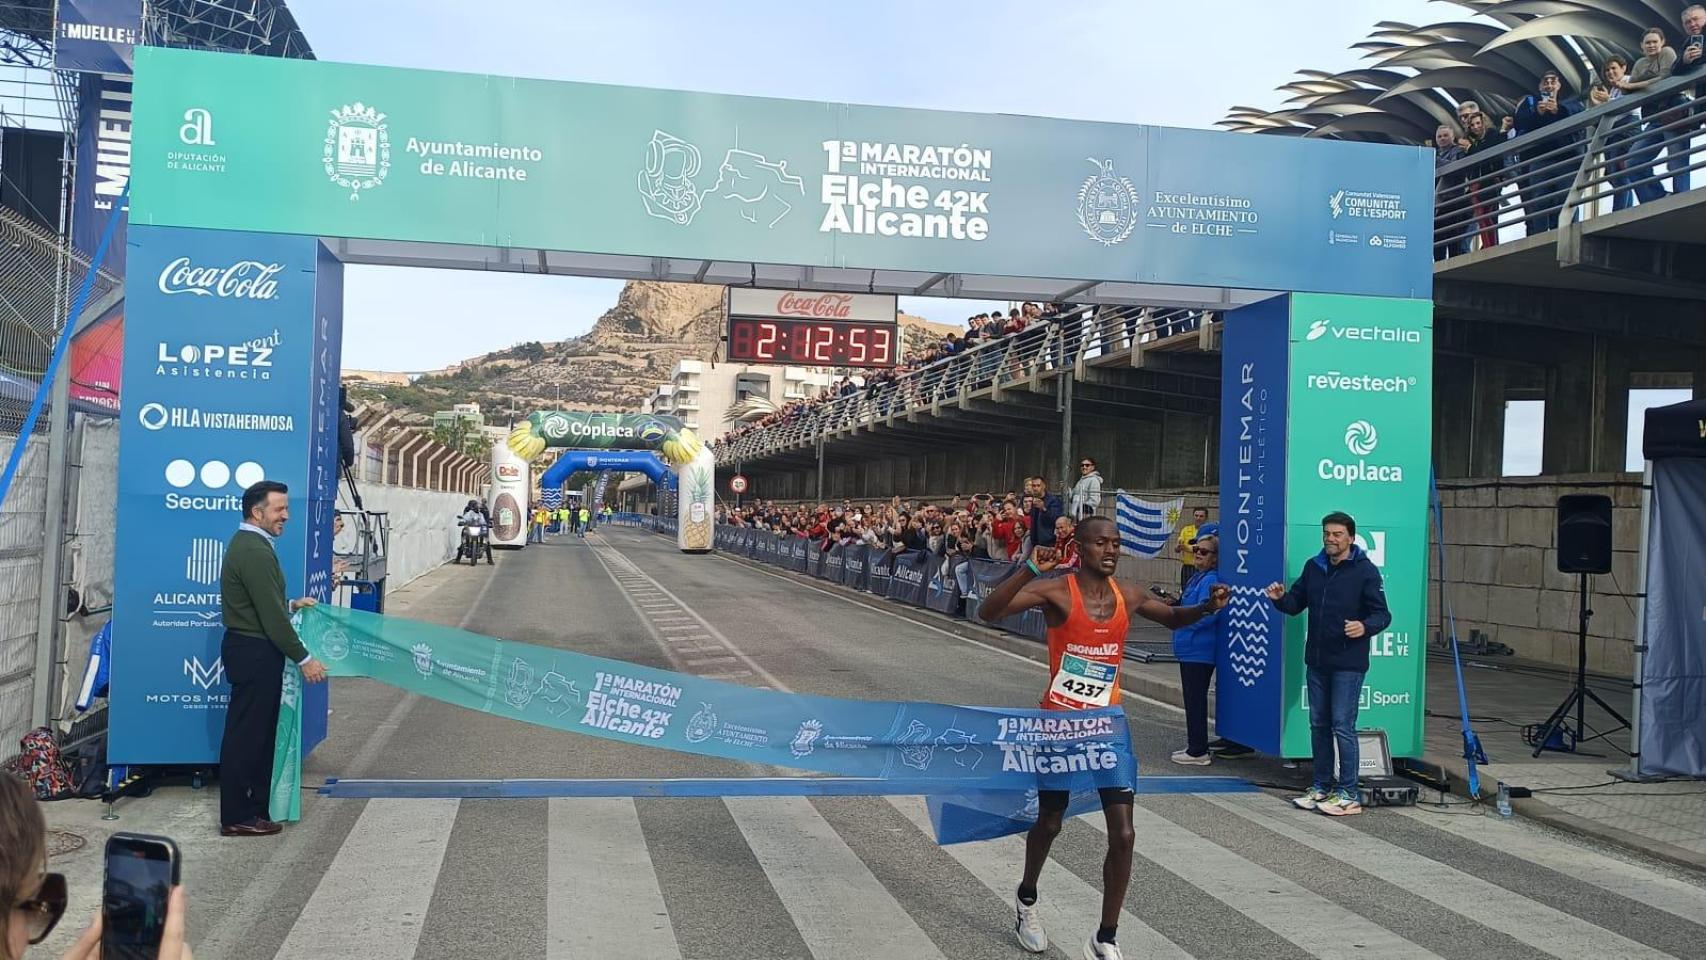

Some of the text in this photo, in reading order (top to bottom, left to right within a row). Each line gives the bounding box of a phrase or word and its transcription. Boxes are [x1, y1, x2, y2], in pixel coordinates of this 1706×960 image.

[68, 23, 125, 43] MUELLE
[167, 151, 226, 163] DIPUTACIÓN
[405, 137, 543, 162] Ayuntamiento
[861, 142, 992, 169] MARATÓN
[167, 161, 225, 172] DE ALICANTE
[420, 159, 528, 182] de Alicante
[860, 162, 991, 182] INTERNACIONAL
[821, 174, 990, 213] Elche 42K
[1155, 191, 1251, 208] Excelentísimo
[1345, 197, 1401, 210] COMUNITAT
[819, 202, 989, 241] Alicante
[1147, 206, 1258, 223] AYUNTAMIENTO
[1349, 207, 1407, 220] DE L'ESPORT
[1171, 222, 1233, 237] de ELCHE
[757, 324, 890, 363] 2:12:53
[1330, 325, 1421, 343] vectalia
[158, 343, 273, 367] LOPEZ
[156, 365, 270, 380] Asistencia
[171, 407, 294, 432] HLA VISTAHERMOSA
[313, 316, 329, 558] MONTEMAR
[571, 421, 633, 439] Coplaca
[1236, 362, 1254, 574] MONTEMAR
[1256, 388, 1268, 545] CLUB ATLÉTICO
[1318, 459, 1403, 486] Coplaca
[894, 564, 923, 583] Alicante
[610, 687, 677, 708] INTERNACIONAL
[613, 675, 682, 700] MARATÓN
[1062, 679, 1106, 698] 4237
[146, 694, 201, 703] MOTOS
[586, 691, 673, 726] Elche 42K
[1373, 691, 1410, 706] Sport
[581, 707, 664, 739] Alicante
[1015, 725, 1114, 741] INTERNACIONAL
[1002, 745, 1117, 774] Alicante
